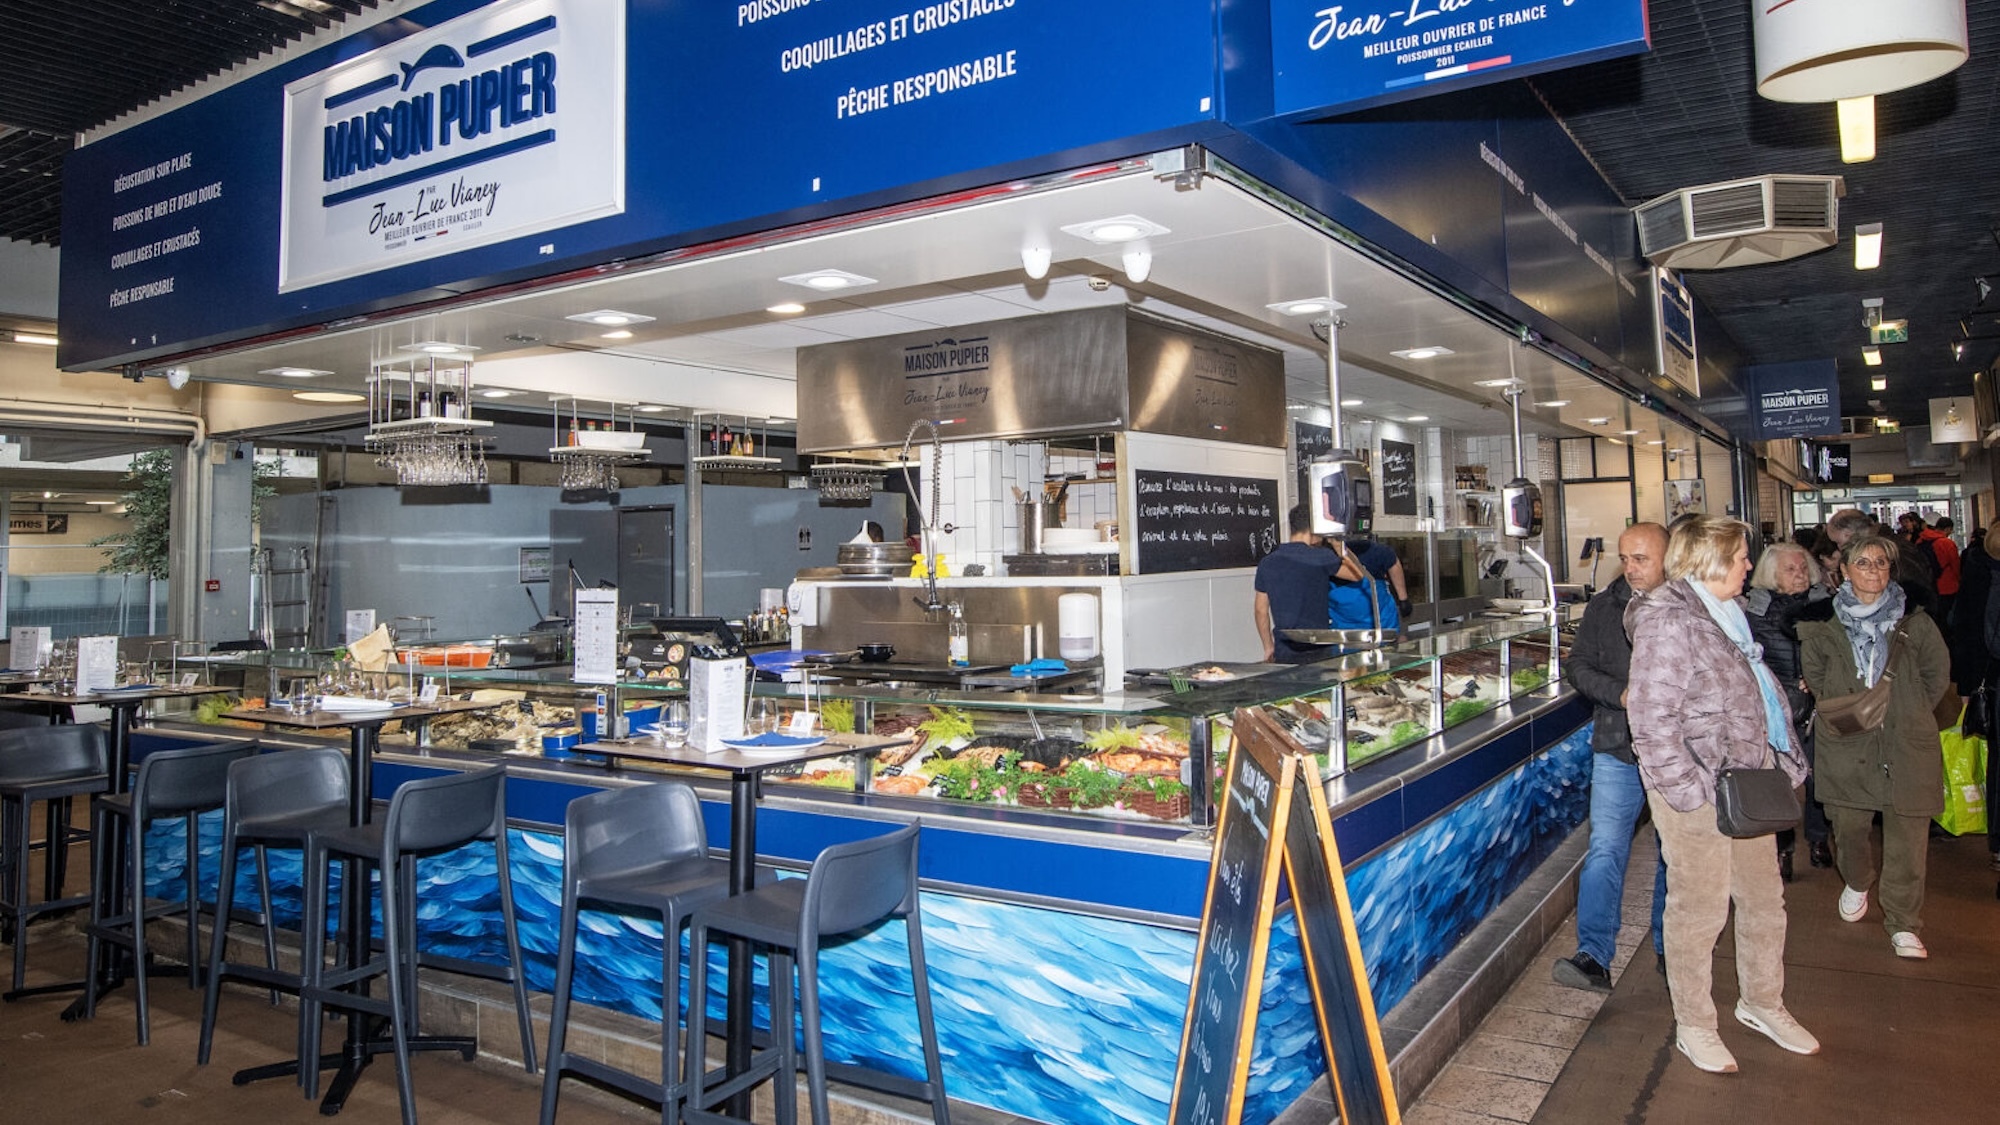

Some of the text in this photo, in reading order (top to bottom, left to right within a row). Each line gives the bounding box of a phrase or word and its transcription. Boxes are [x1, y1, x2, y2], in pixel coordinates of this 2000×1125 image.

[738, 0, 810, 27] POISSO
[1363, 4, 1547, 59] MEILLEUR OUVRIER DE FRANCE
[781, 21, 886, 73] COQUILLAGES
[890, 14, 909, 41] ET
[1396, 35, 1494, 65] POISSONNIER ECAILLER
[1435, 55, 1456, 68] 2011
[837, 50, 1017, 120] PÊCHE RESPONSABLE
[323, 51, 556, 181] MAISON PUPIER
[114, 152, 192, 194] DÉGUSTATION SUR PLACE
[113, 181, 222, 231] POISSONS DE MER ET D'EAU DOUCE
[369, 188, 447, 235] Jean-Luc
[385, 208, 482, 241] MEILLEUR OUVRIER DE FRANCE 2011
[111, 226, 200, 269] COQUILLAGES ET CRUSTACÉS
[130, 277, 174, 303] RESPONSABLE
[905, 345, 989, 372] MAISON PUPIER
[1761, 393, 1829, 409] MAISON PUPIER
